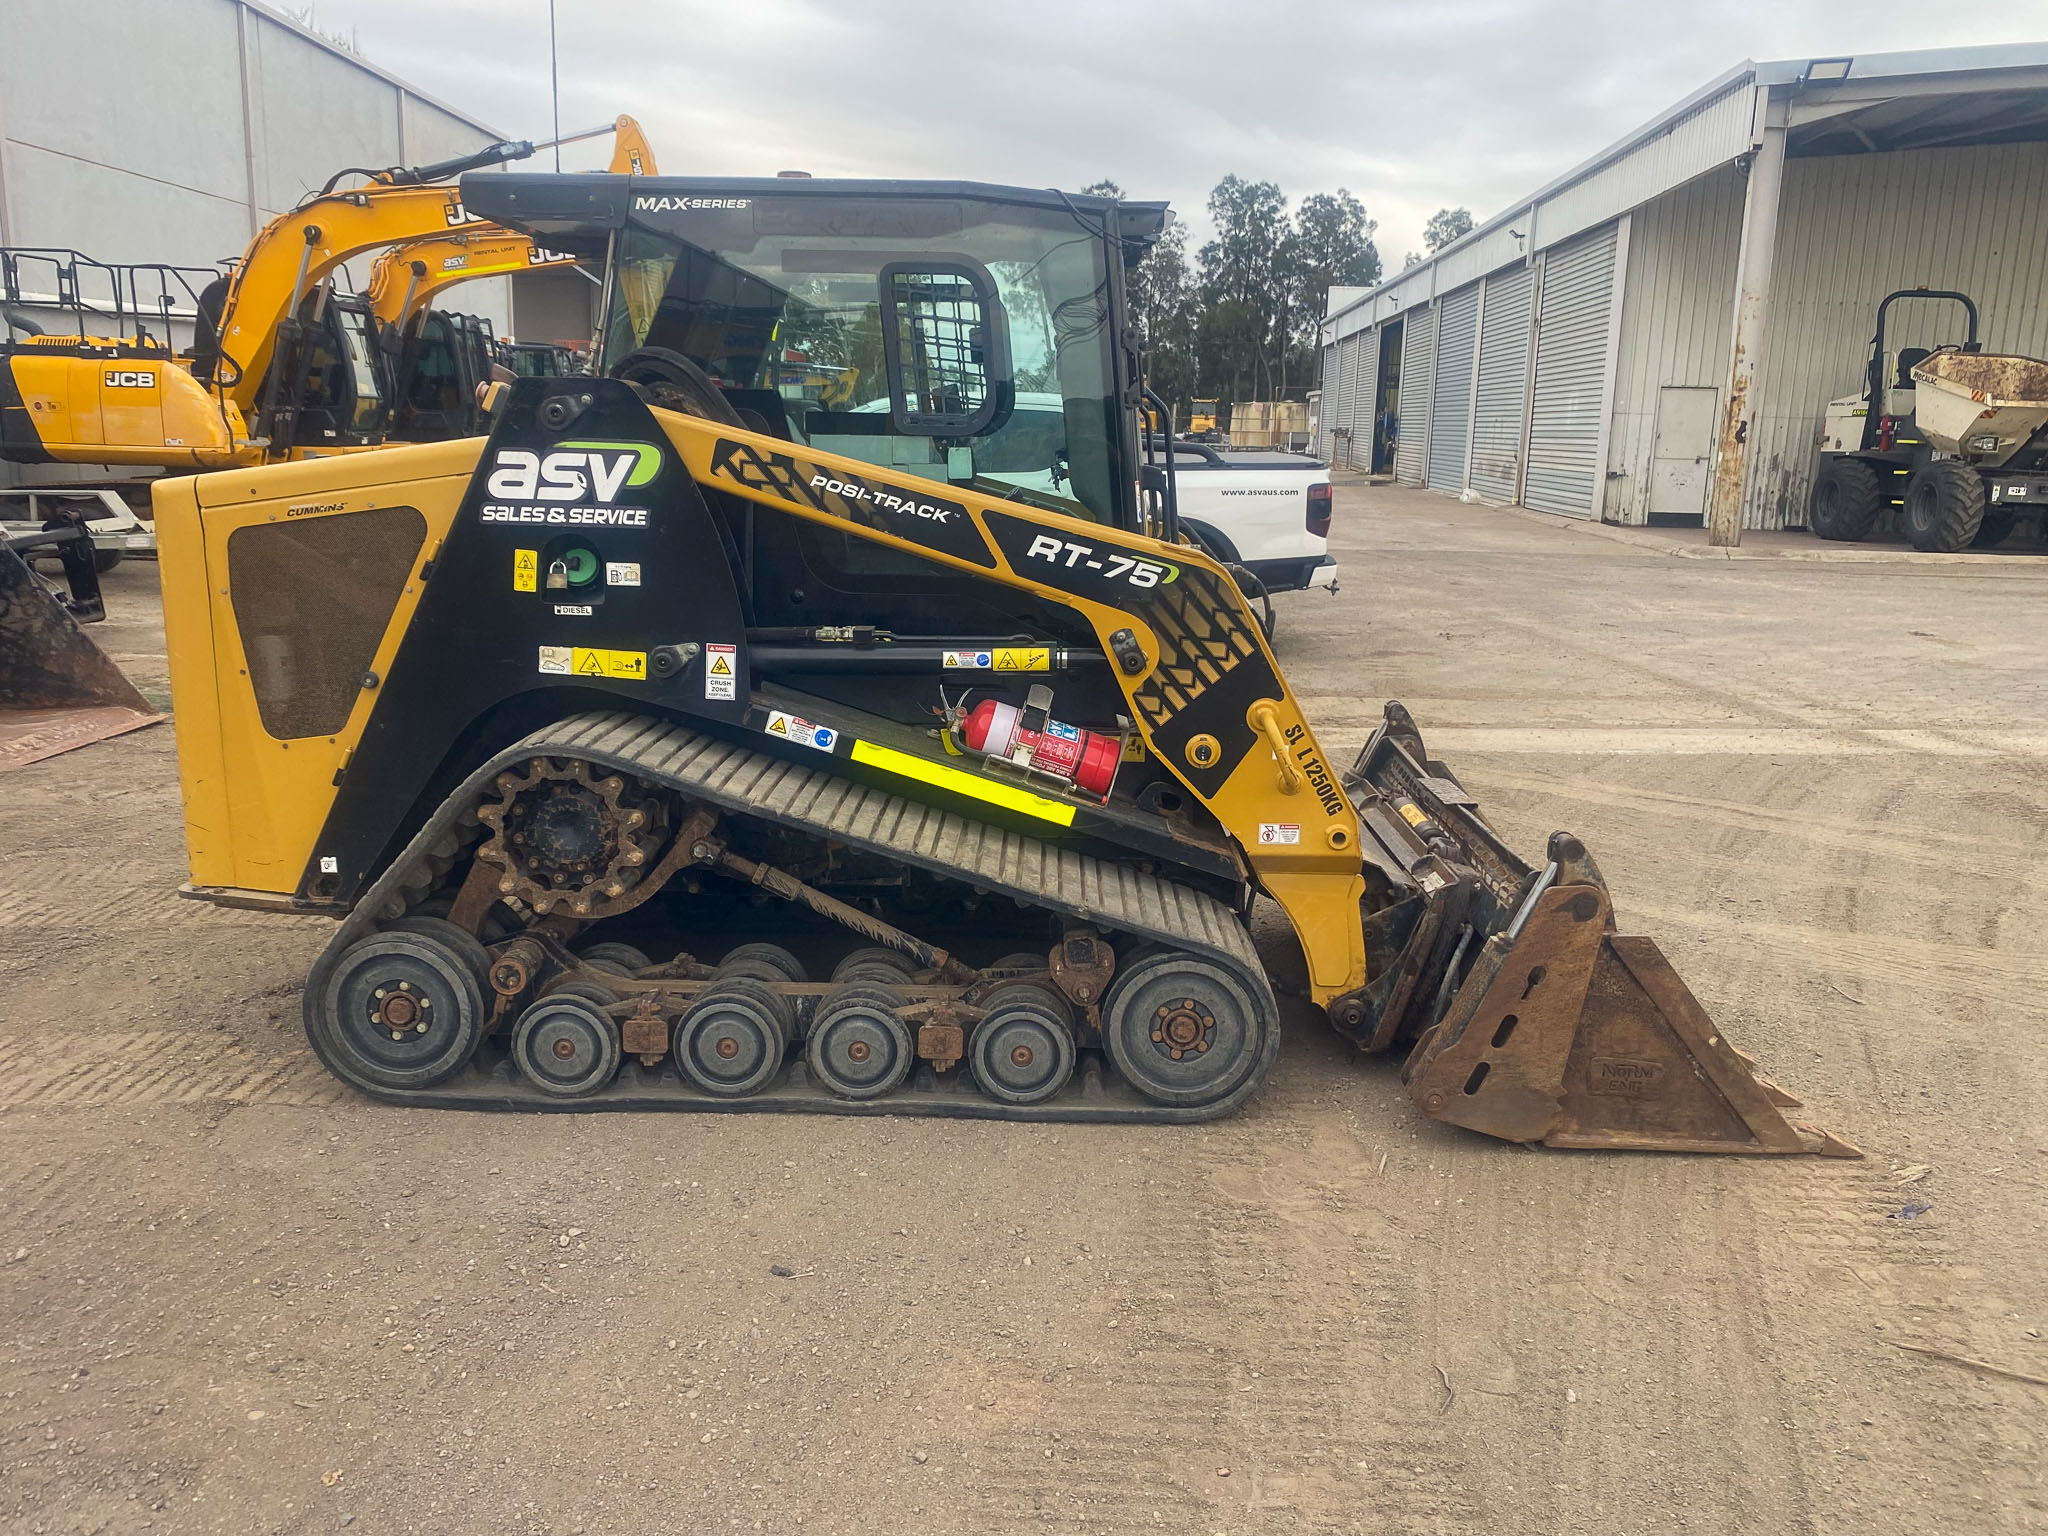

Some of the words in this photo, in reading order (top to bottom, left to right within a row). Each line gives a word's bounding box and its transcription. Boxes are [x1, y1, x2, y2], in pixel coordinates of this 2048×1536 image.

[106, 372, 155, 387] JCB
[809, 475, 952, 524] POSI-TRACK
[1221, 488, 1299, 497] www.asvaus.com
[287, 503, 345, 517] CUMMINS
[546, 507, 567, 523] &
[569, 508, 648, 526] SERVICE
[1026, 534, 1164, 589] RT-75
[562, 606, 591, 614] DIESEL
[710, 679, 732, 687] CRUSH
[1284, 724, 1305, 746] SL
[1302, 758, 1343, 817] 1250KG
